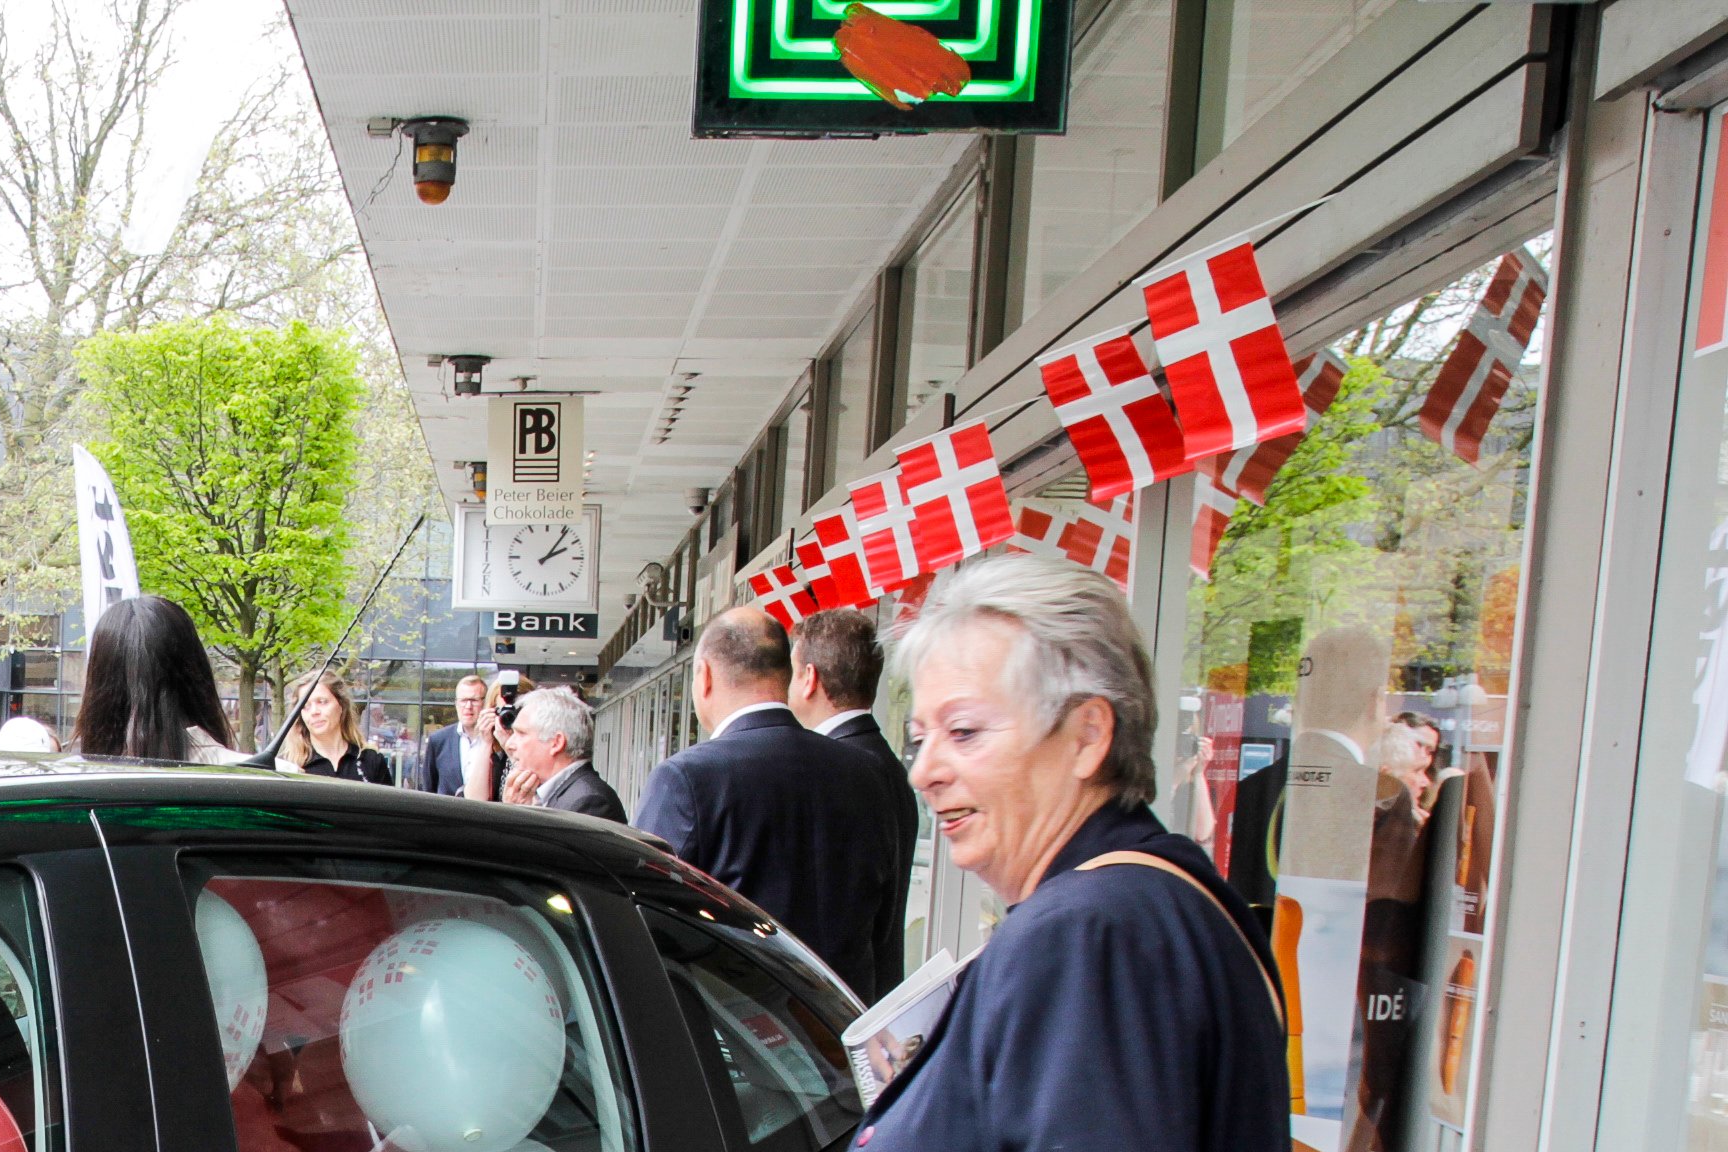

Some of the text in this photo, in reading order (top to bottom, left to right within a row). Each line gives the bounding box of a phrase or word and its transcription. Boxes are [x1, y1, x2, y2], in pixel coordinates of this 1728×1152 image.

[519, 408, 556, 454] PB
[494, 488, 575, 501] Peter Beier
[493, 505, 574, 520] Chokolade
[494, 612, 586, 632] Bank
